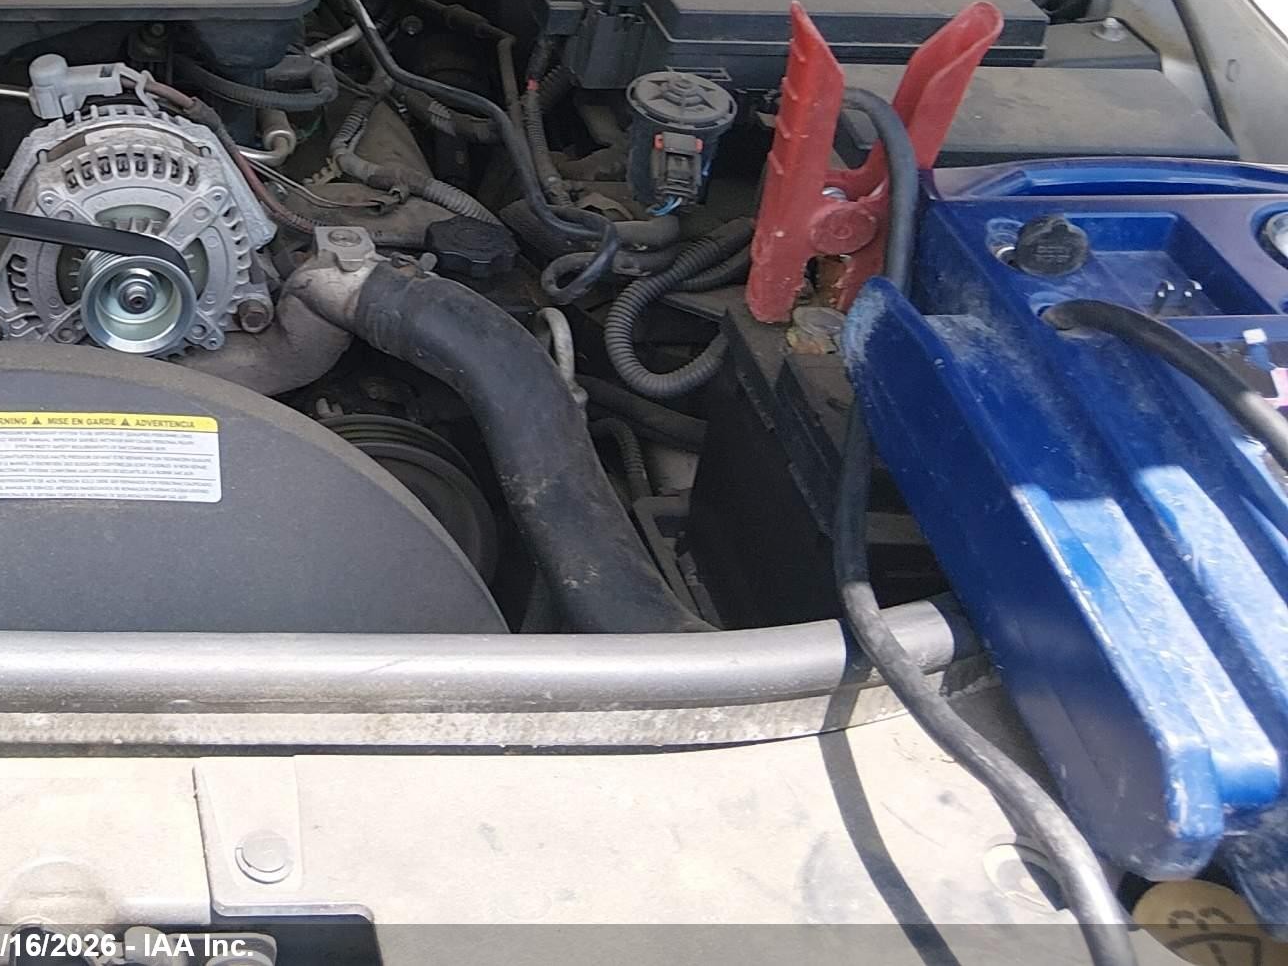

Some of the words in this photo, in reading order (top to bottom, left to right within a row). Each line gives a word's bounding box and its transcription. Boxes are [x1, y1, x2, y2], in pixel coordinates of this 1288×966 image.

[48, 417, 69, 425] MISE
[71, 417, 83, 425] EN
[86, 418, 116, 426] GARDE
[135, 419, 196, 428] ADVERTENCIA
